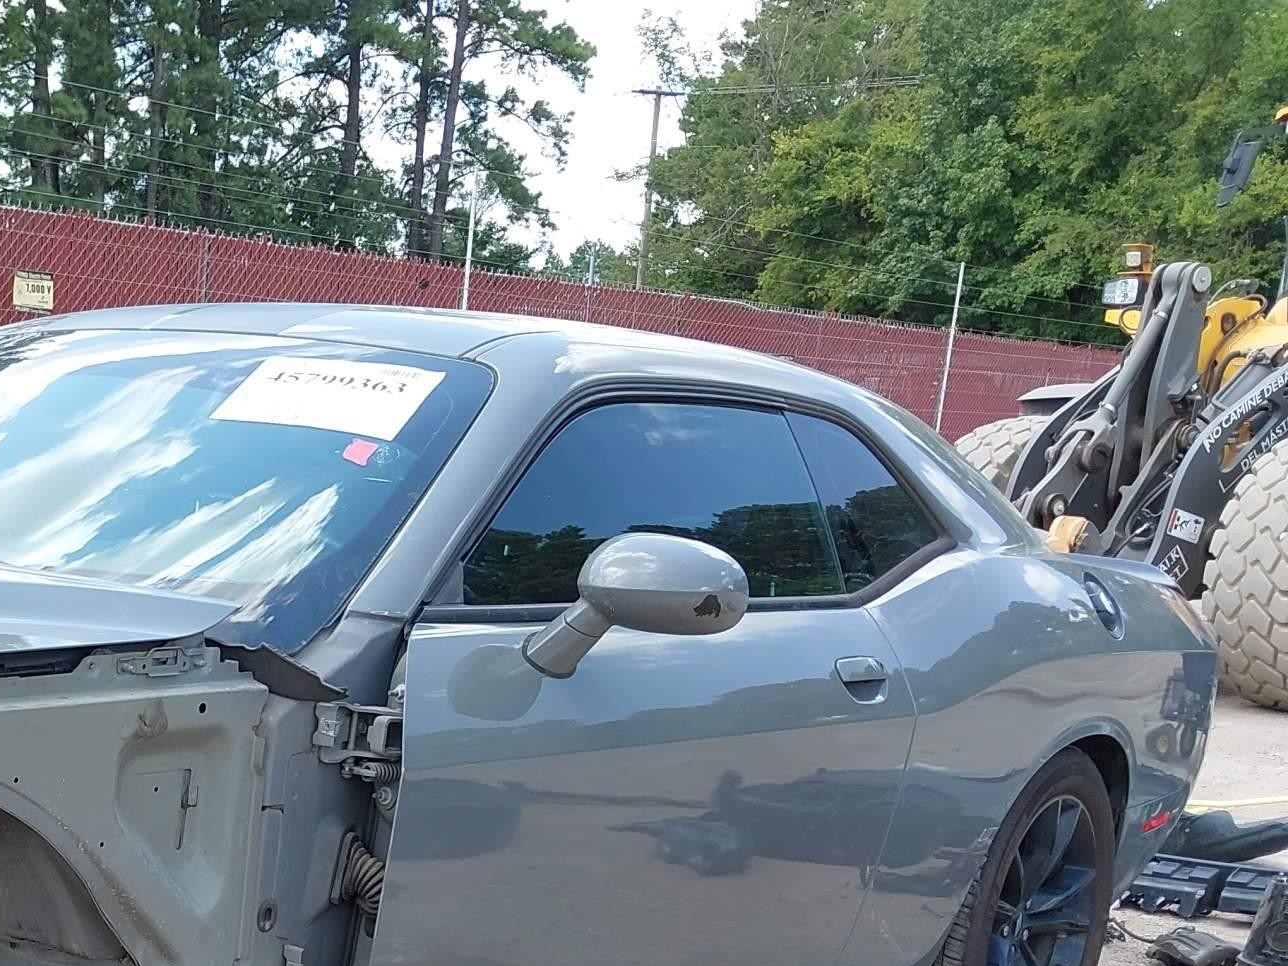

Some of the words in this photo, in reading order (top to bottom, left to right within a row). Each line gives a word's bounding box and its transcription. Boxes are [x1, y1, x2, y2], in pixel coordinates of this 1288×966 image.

[267, 371, 407, 393] 45799363
[1222, 393, 1263, 429] CAMINE
[1240, 449, 1262, 472] DEL
